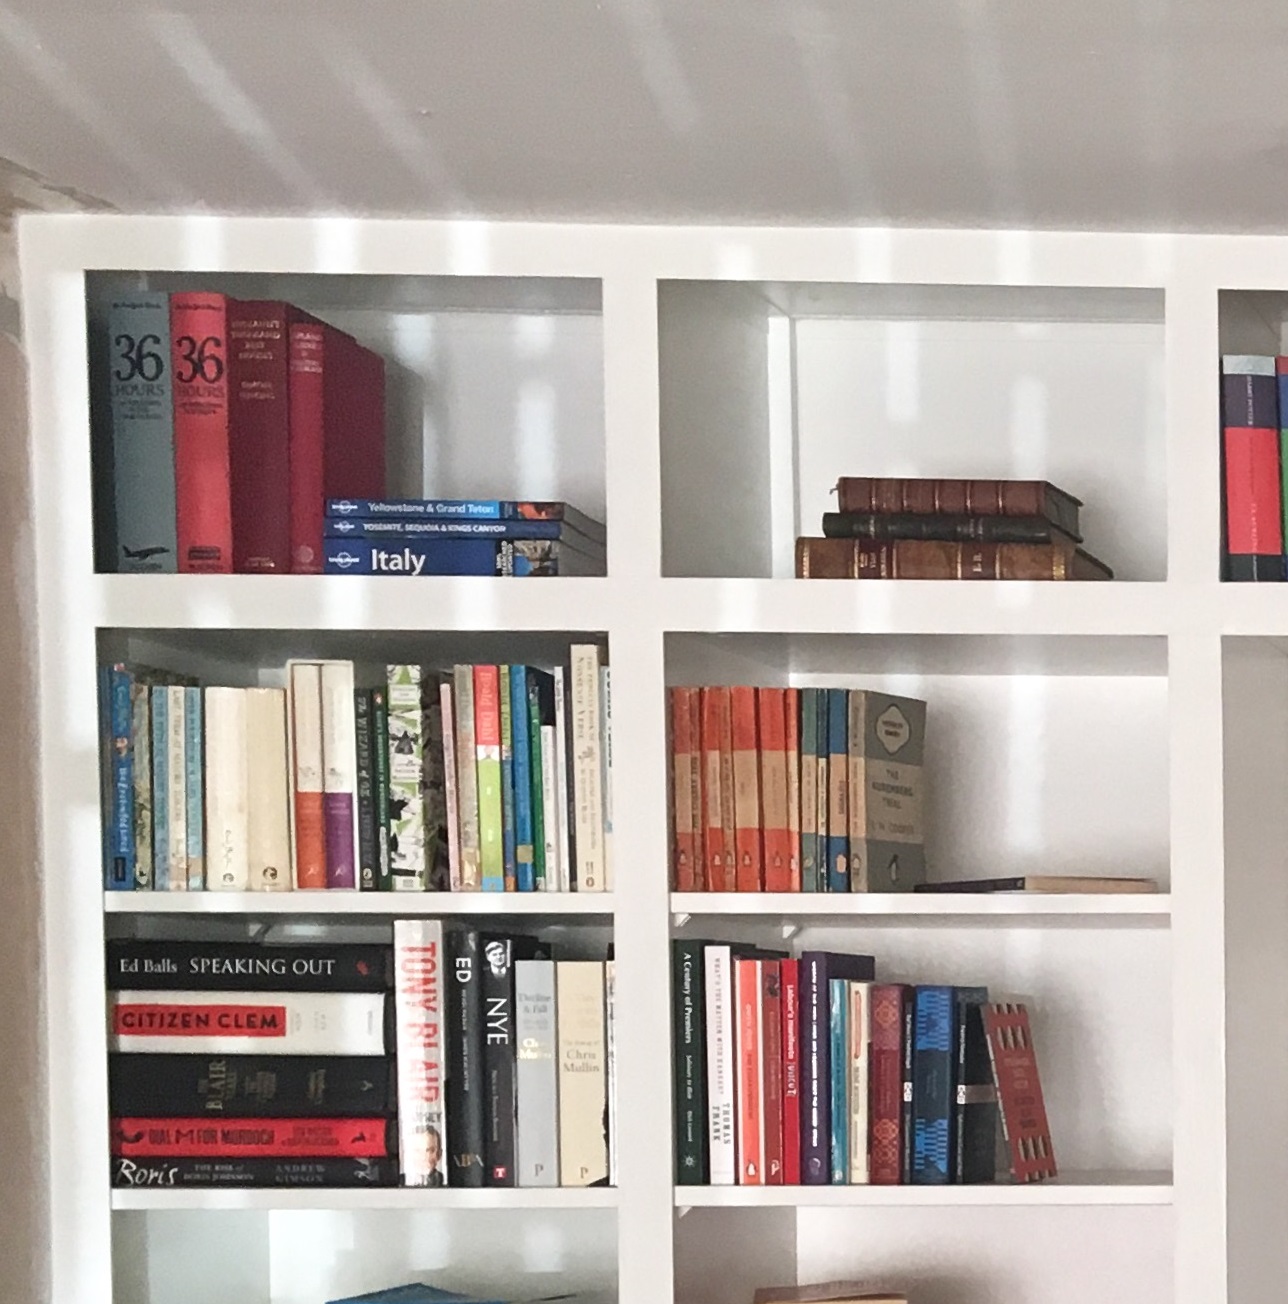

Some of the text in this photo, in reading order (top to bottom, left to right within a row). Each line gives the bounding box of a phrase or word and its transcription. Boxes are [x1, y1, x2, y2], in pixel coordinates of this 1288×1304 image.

[115, 334, 164, 382] 36
[177, 336, 223, 383] 36
[115, 385, 165, 397] HOURS
[178, 384, 224, 397] HOURS
[368, 502, 424, 512] Yellowstone
[436, 503, 465, 513] Grand
[468, 504, 494, 513] Teton
[372, 548, 425, 575] Italy
[481, 672, 494, 741] Roald Dahl
[358, 717, 368, 766] WIZARD
[120, 958, 335, 975] Ed Balls SPEAKING OUT
[401, 942, 437, 1013] TONY
[455, 957, 471, 983] ED
[683, 952, 693, 1043] A Century of Premiers
[122, 1012, 278, 1028] CITIZEN CLEM
[487, 998, 508, 1045] NYE
[206, 1059, 227, 1110] BLAIR
[564, 1063, 600, 1073] Mullin
[713, 1106, 721, 1141] FRANK
[723, 1103, 731, 1145] THOMAS
